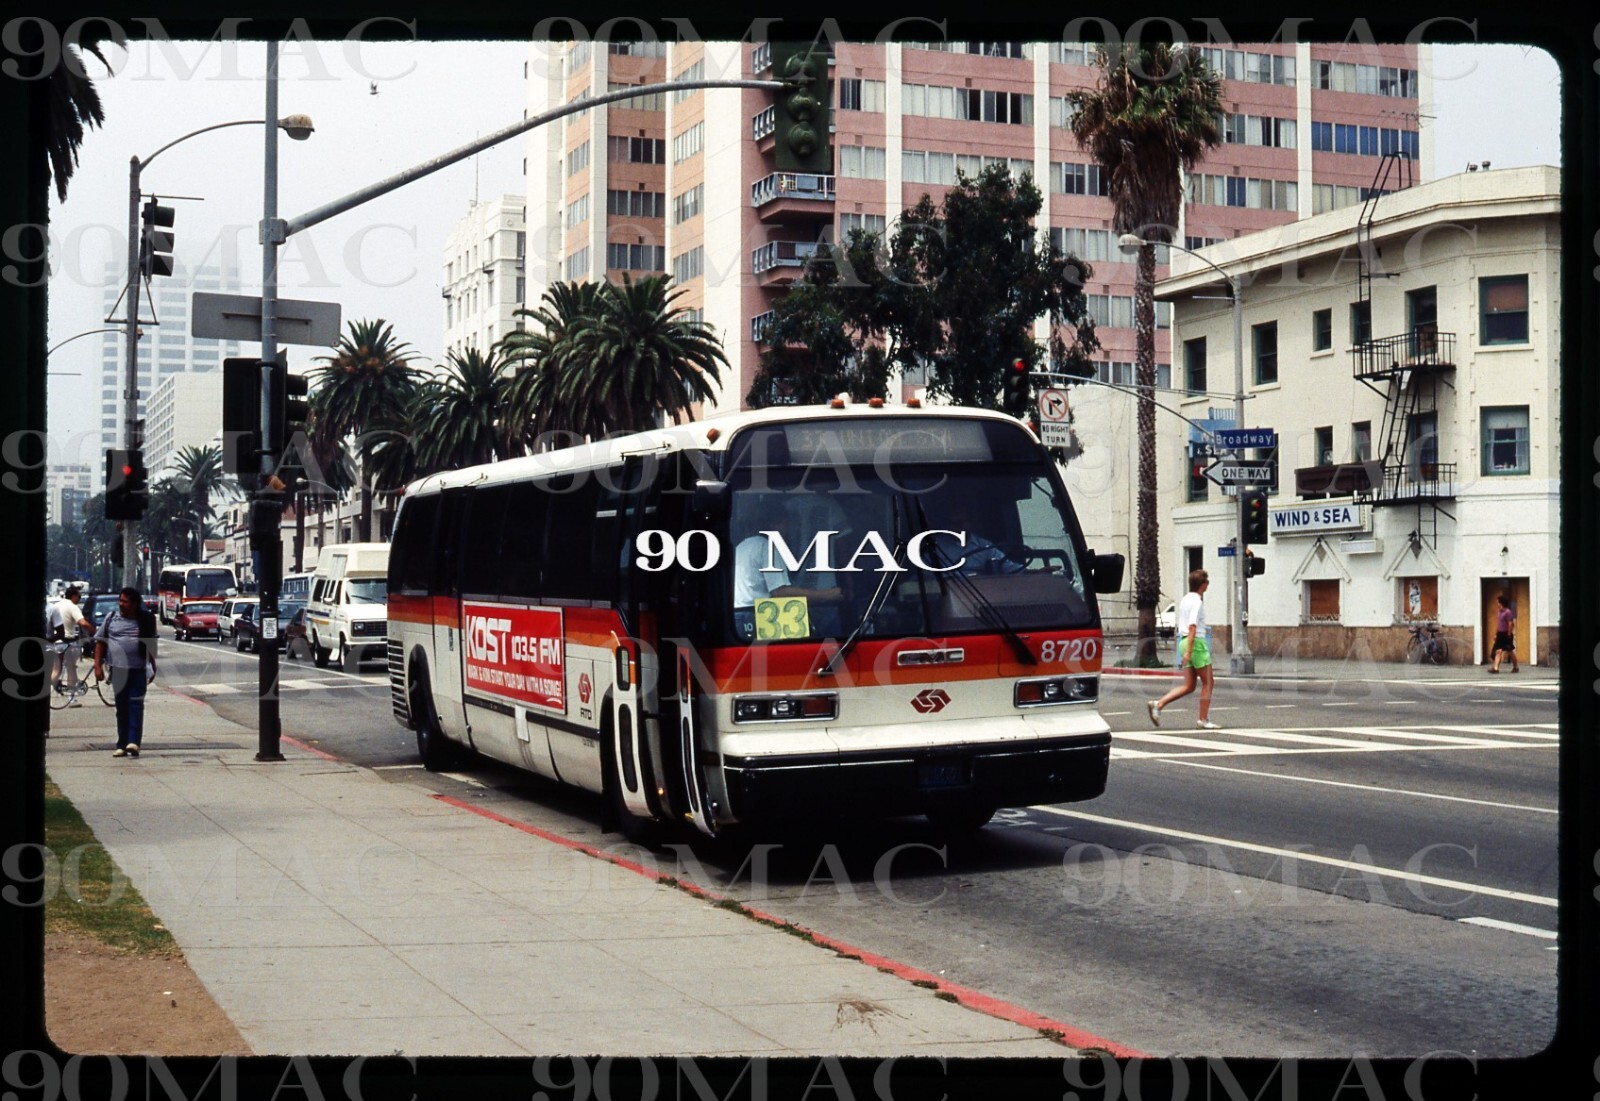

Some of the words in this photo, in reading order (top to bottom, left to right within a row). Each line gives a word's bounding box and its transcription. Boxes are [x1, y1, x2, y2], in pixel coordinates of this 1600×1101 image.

[1050, 424, 1069, 434] RIGHT
[1046, 435, 1066, 443] TURN
[1215, 433, 1273, 446] Broadway
[1221, 468, 1244, 478] ONE
[1247, 467, 1269, 479] WAY
[1275, 510, 1310, 527] WIND
[1314, 511, 1320, 522] &
[1322, 507, 1351, 524] SEA
[757, 600, 807, 639] 33
[466, 614, 512, 665] KOST
[511, 635, 537, 663] 103.5
[540, 637, 561, 665] FM
[1041, 638, 1097, 663] 8720
